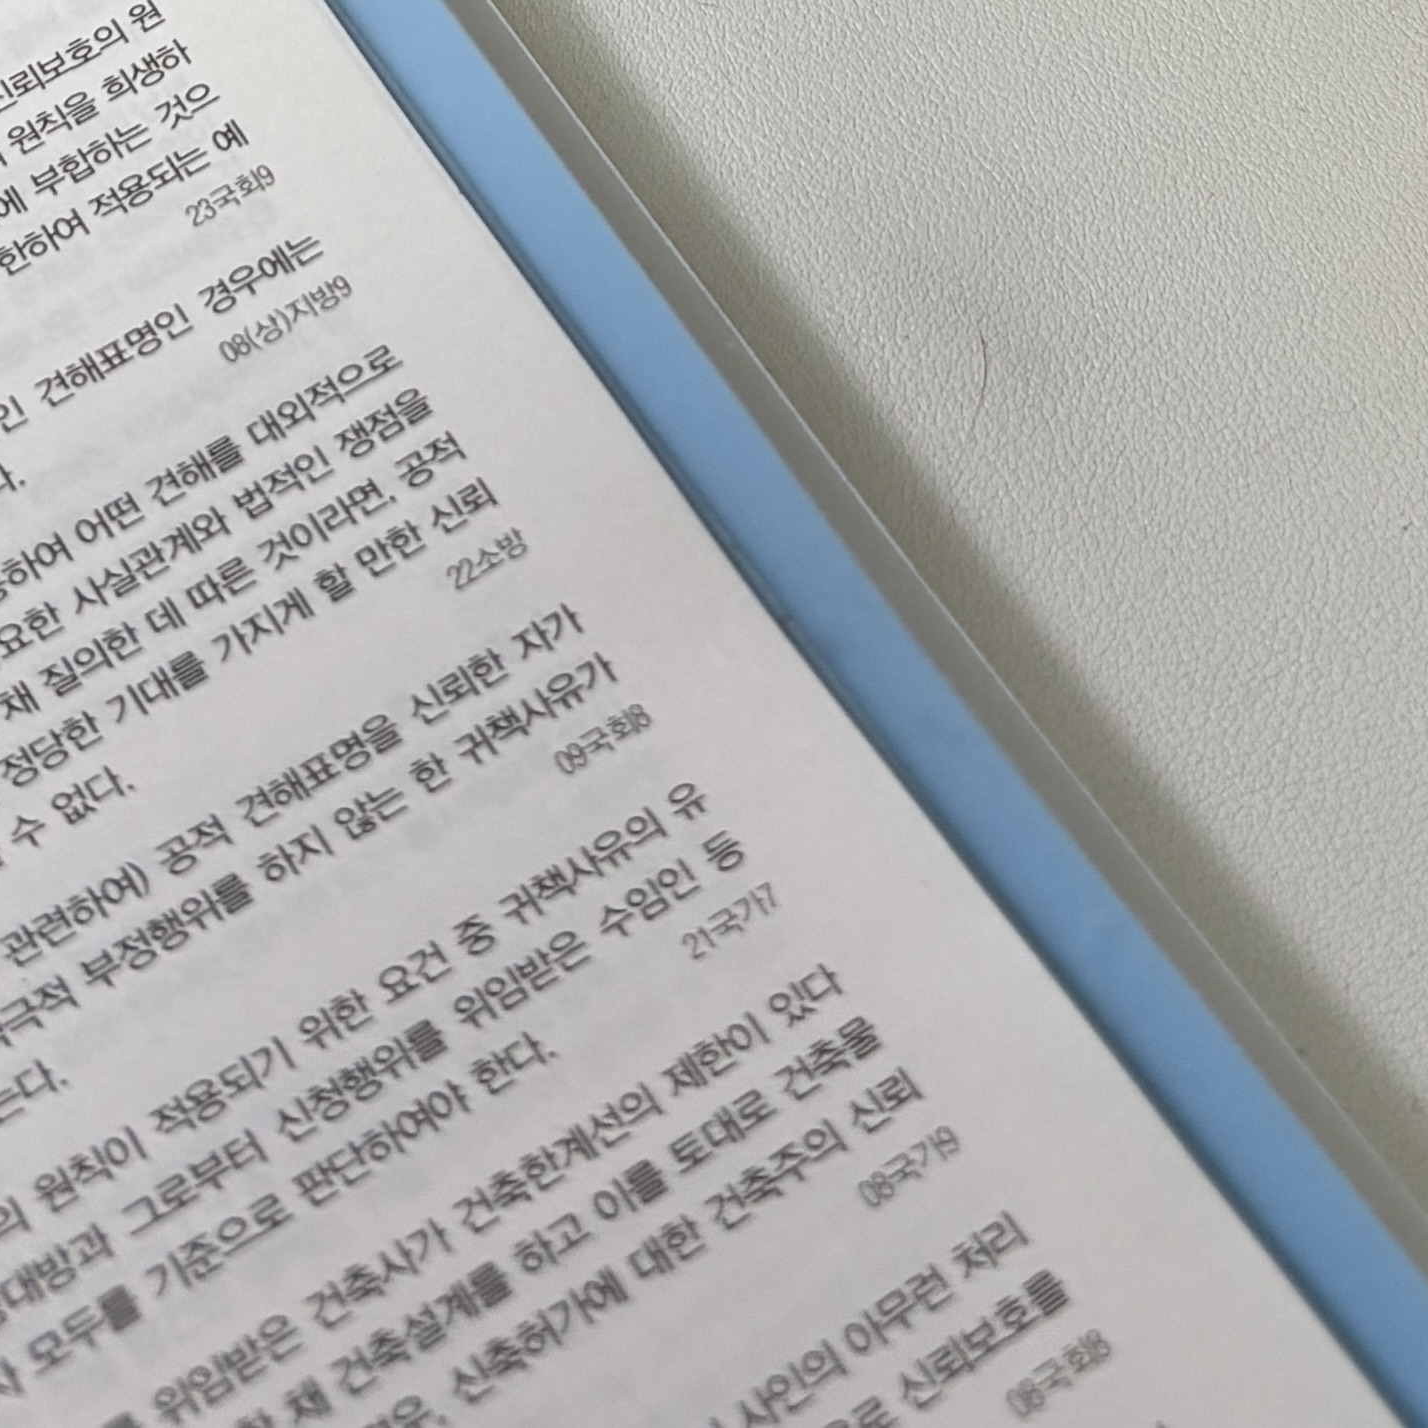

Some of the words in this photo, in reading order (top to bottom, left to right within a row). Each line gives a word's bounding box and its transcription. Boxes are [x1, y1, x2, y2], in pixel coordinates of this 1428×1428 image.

[34, 303, 194, 408] 견해표명인
[198, 235, 324, 315] 경우에는
[74, 491, 146, 545] 어떤
[144, 434, 246, 508] 견해를
[245, 344, 404, 446] 대외적으로
